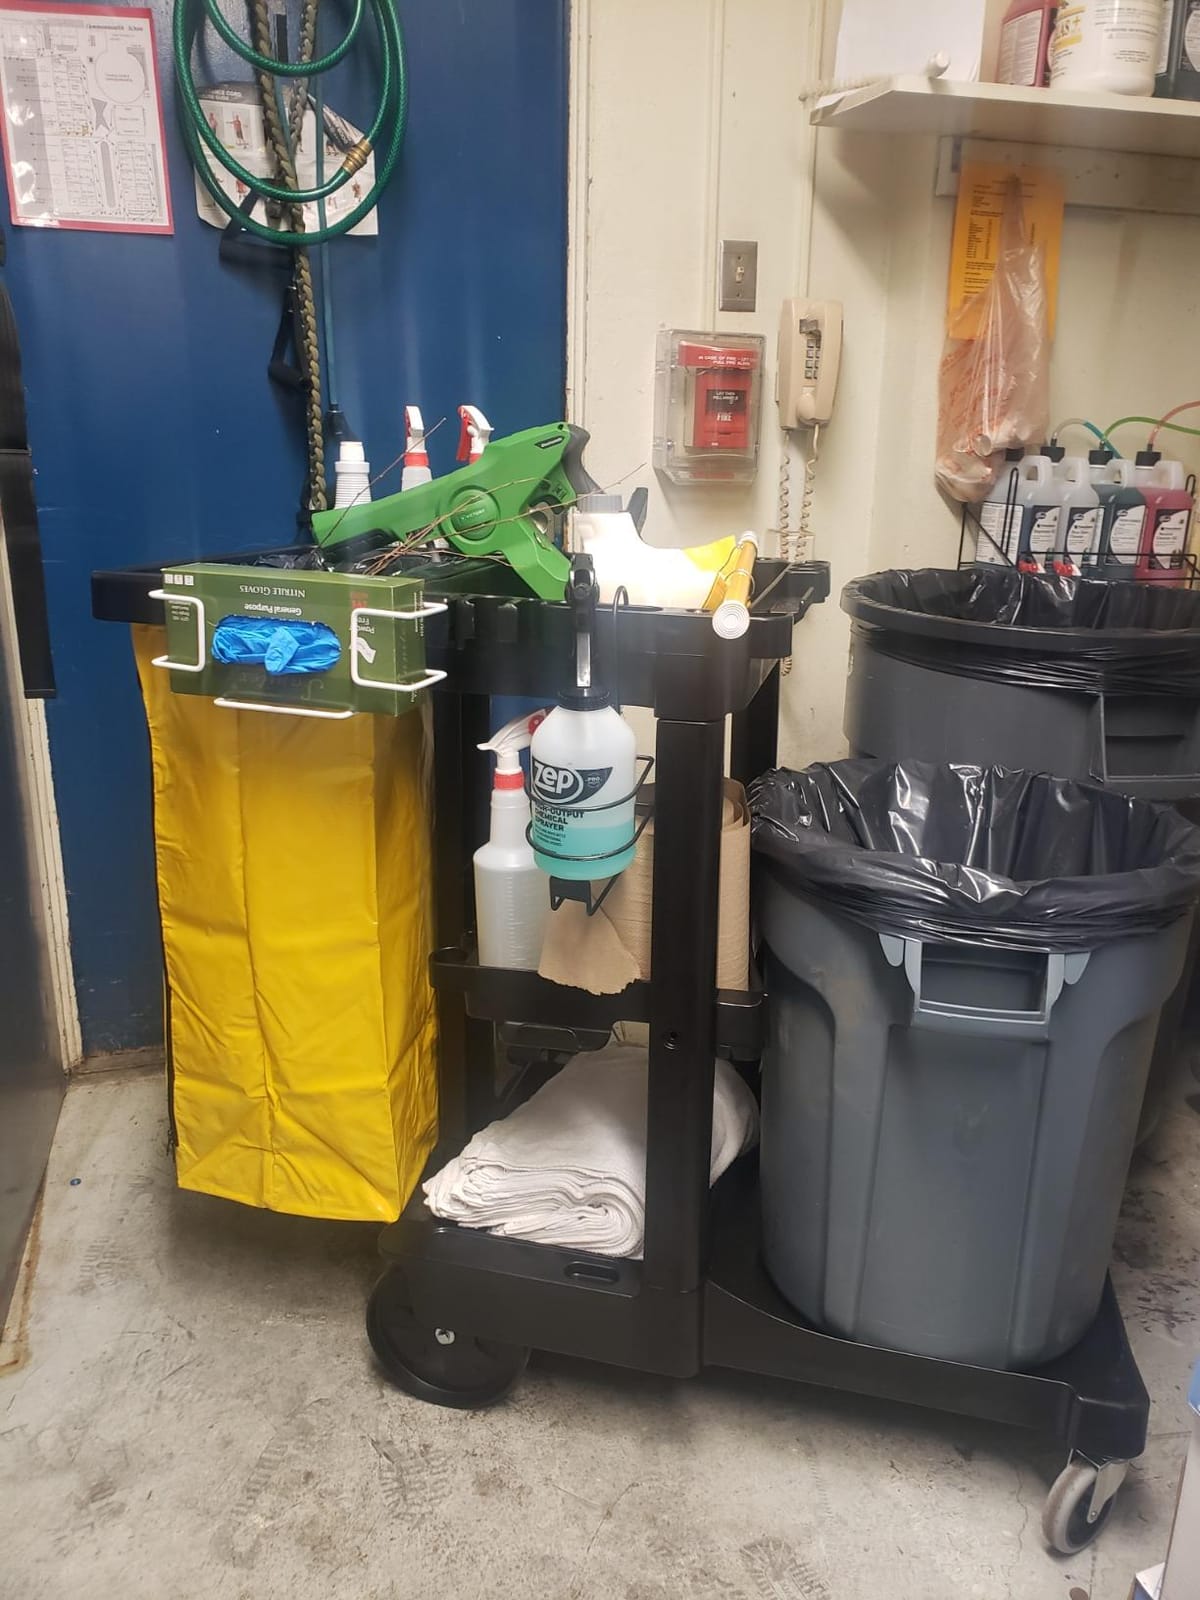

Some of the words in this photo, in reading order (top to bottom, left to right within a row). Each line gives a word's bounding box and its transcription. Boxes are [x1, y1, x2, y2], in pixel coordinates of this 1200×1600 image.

[716, 412, 732, 422] FIRE
[239, 584, 271, 597] GLOVES
[271, 586, 306, 599] NITRILE
[244, 602, 274, 616] Purpose
[275, 604, 304, 616] General
[534, 808, 569, 826] CHEMICAL
[534, 815, 565, 832] SPRAYER
